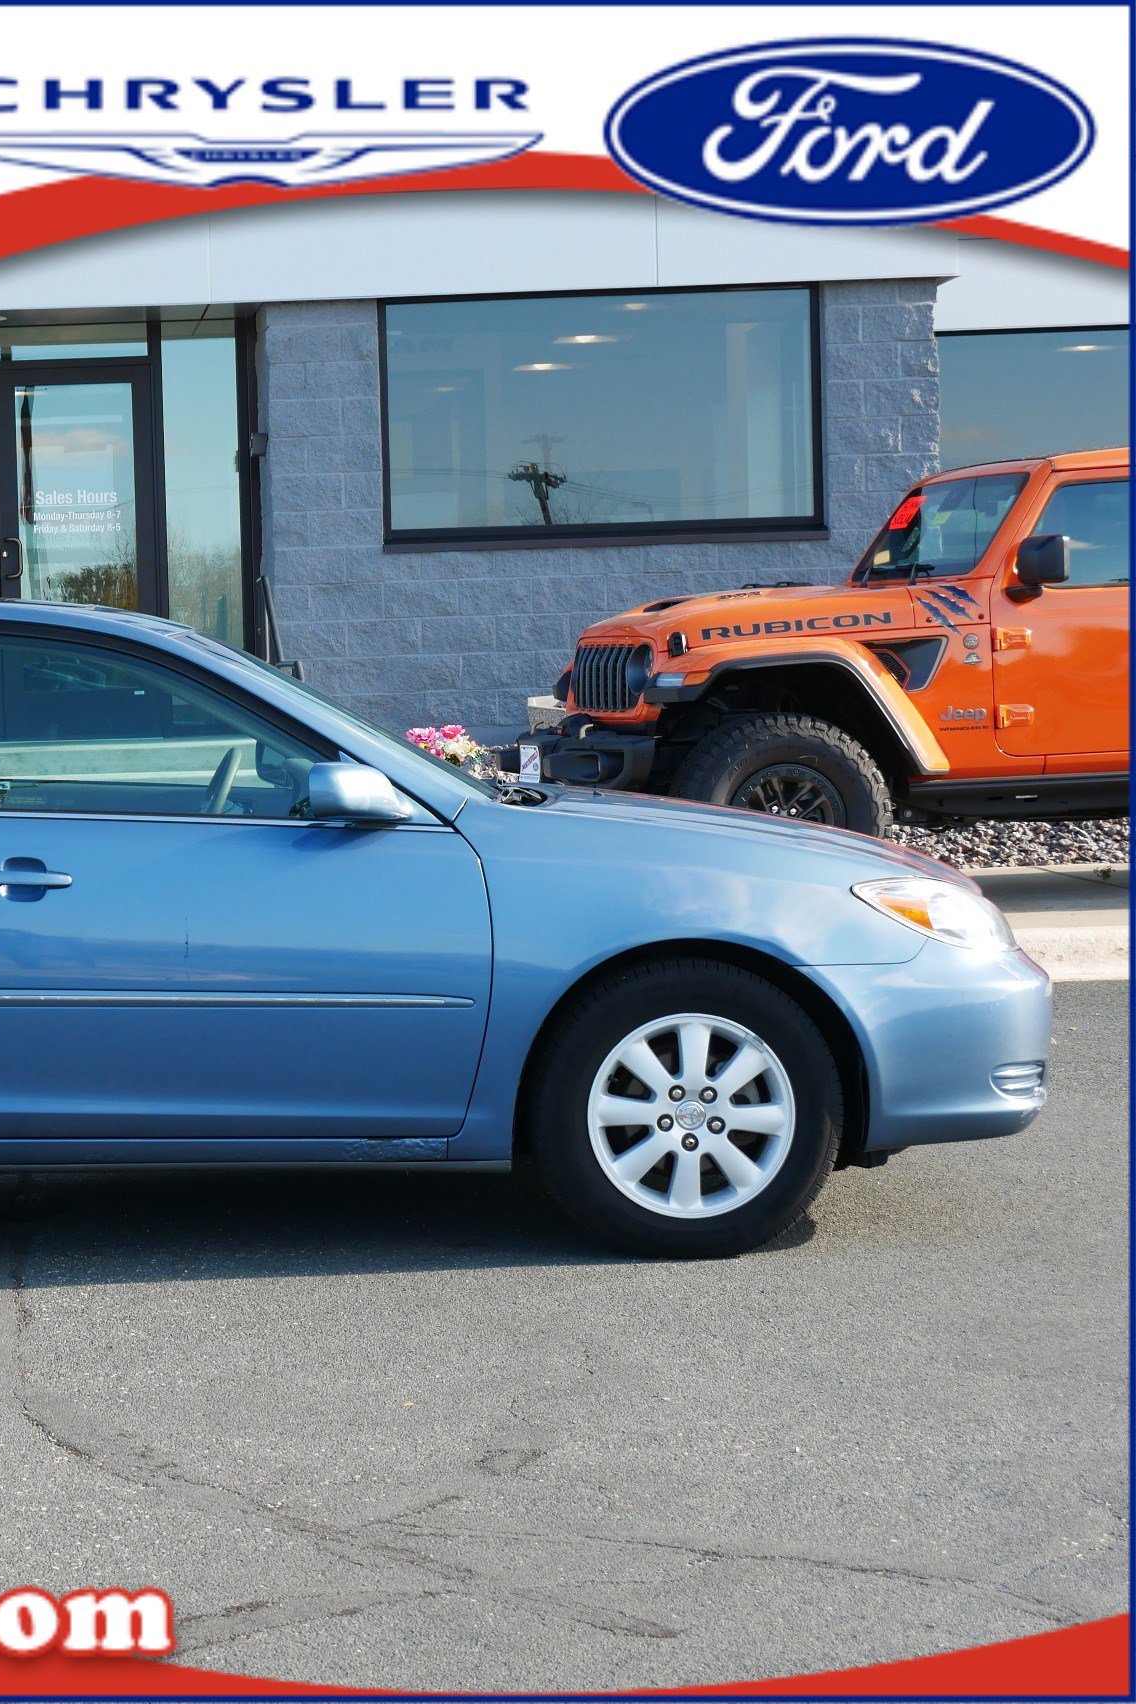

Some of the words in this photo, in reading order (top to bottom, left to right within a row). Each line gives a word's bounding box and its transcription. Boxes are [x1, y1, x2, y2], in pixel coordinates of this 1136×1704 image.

[35, 490, 72, 505] Sales
[77, 489, 118, 504] Hours
[33, 511, 105, 522] Monday-Thursday
[106, 510, 121, 519] 8-7
[33, 524, 58, 534] Friday
[60, 524, 66, 532] &
[69, 523, 105, 533] Saturday
[106, 522, 121, 532] 8-5
[701, 611, 892, 641] RUBICON
[939, 705, 987, 723] Jeep
